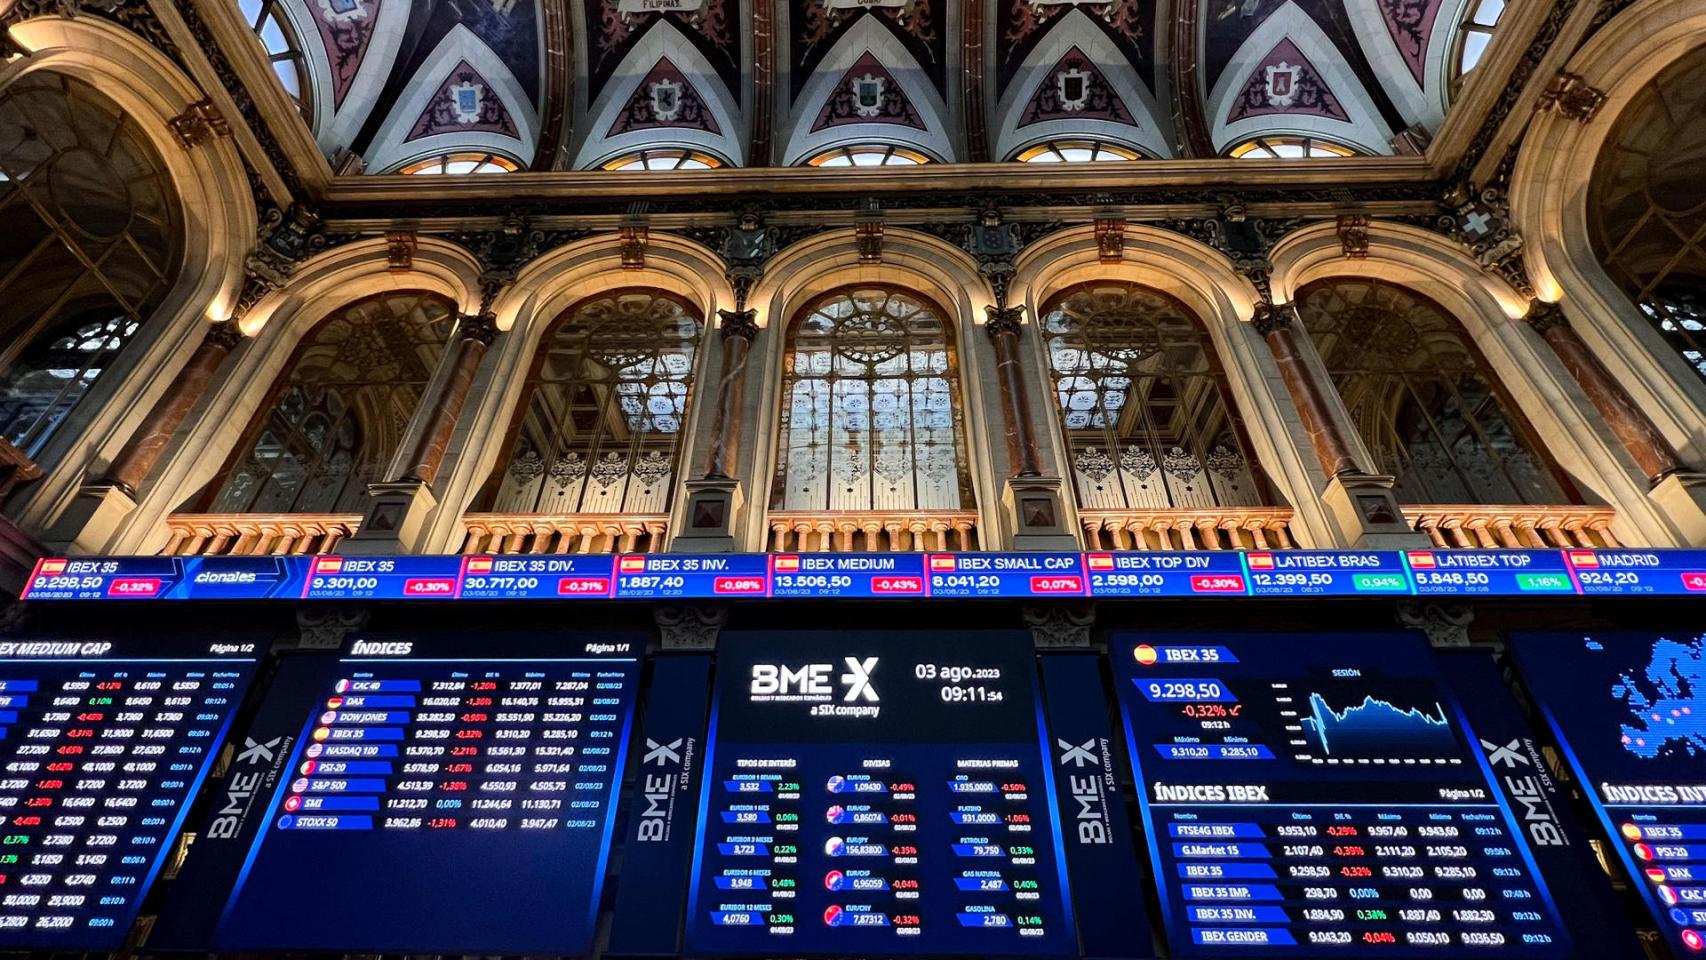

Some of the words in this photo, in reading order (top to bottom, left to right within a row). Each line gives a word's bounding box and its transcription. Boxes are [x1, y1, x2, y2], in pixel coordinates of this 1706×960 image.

[648, 560, 680, 570] IBEX
[682, 560, 699, 570] 35
[702, 560, 729, 570] INV.
[802, 559, 835, 570] IBEX
[838, 559, 895, 570] MEDIUM
[958, 558, 992, 569] IBEX
[995, 558, 1042, 569] SMALL
[1044, 558, 1074, 569] CAP
[1116, 557, 1150, 568] IBEX
[1151, 557, 1182, 568] TOP
[1186, 557, 1210, 568] DIV
[1275, 556, 1337, 568] LATIBEX
[1339, 556, 1380, 567] BRAS
[1436, 555, 1499, 567] LATIBEX
[1500, 555, 1531, 566] TOP
[1599, 554, 1660, 566] MADRID
[67, 562, 100, 573] IBEX
[101, 562, 119, 573] 35
[343, 561, 376, 572] IBEX
[378, 561, 395, 572] 35
[494, 560, 527, 572] IBEX
[529, 561, 546, 572] 35
[548, 560, 575, 572] DIV.
[34, 576, 102, 589] 9.298,50
[194, 571, 257, 583] cionales
[1092, 574, 1164, 587] 2.598,00
[1197, 579, 1238, 588] -0,30%
[1252, 574, 1333, 587] 12.399,50
[1362, 578, 1399, 587] 0,94%
[1415, 573, 1489, 585] 5.848,50
[1528, 577, 1562, 587] 1,16%
[1580, 572, 1639, 585] 924,20
[313, 578, 377, 589] 9.301,00
[410, 582, 450, 592] -0,30%
[465, 578, 538, 589] 30.717,00
[565, 582, 603, 592] -0,31%
[620, 577, 684, 589] 1.887,40
[775, 576, 851, 588] 13.506,50
[876, 581, 918, 590] -0,43%
[932, 576, 1000, 588] 8.041,20
[1036, 580, 1077, 590] -0,07%
[17, 642, 81, 655] MEDIUM
[81, 642, 111, 655] CAP
[210, 644, 239, 653] Página
[240, 644, 254, 652] 1/2
[351, 640, 413, 654] ÍNDICES
[586, 644, 615, 653] Página
[616, 644, 630, 652] 1/1
[1165, 649, 1200, 660] IBEX
[1201, 649, 1219, 660] 35
[915, 664, 936, 678] 03
[751, 664, 833, 694] BME
[353, 682, 368, 690] CAC
[370, 682, 380, 690] 40
[942, 686, 1002, 701] 09:11:54
[1149, 684, 1220, 700] 9.298,50
[346, 698, 364, 706] DAX
[810, 706, 818, 715] a
[818, 704, 835, 715] SIX
[836, 706, 880, 718] company
[1182, 705, 1226, 718] -0,32%
[358, 713, 388, 722] JONES
[333, 730, 352, 738] IBEX
[353, 730, 364, 738] 35
[274, 736, 294, 769] company
[326, 747, 361, 755] NASDAQ
[684, 738, 696, 770] company
[1100, 738, 1112, 772] company
[1171, 748, 1208, 757] 9.310,20
[1221, 748, 1258, 757] 9.285,10
[319, 764, 346, 772] PSI-20
[486, 764, 521, 772] 6.054,16
[534, 764, 570, 772] 5.971,64
[863, 760, 890, 768] DIVISAS
[958, 760, 991, 768] MATERIAS
[681, 772, 690, 784] SIX
[1105, 773, 1114, 785] SIX
[312, 782, 330, 790] S&P
[480, 782, 516, 790] 4.550,93
[530, 782, 566, 790] 4.505,75
[954, 784, 992, 792] 1.935,0000
[1154, 782, 1224, 800] ÍNDICES
[1227, 786, 1269, 800] IBEX
[1440, 789, 1469, 800] Página
[1470, 789, 1485, 798] 1/2
[1602, 782, 1678, 802] ÍNDICES
[207, 772, 259, 838] BME
[304, 800, 322, 808] SMI
[638, 774, 671, 841] BME
[1070, 775, 1106, 844] BME
[1504, 776, 1563, 846] BME
[296, 818, 326, 826] STOXX
[326, 818, 338, 826] 50
[470, 819, 507, 828] 4.010,40
[521, 819, 558, 828] 3.947,47
[1212, 826, 1235, 836] IBEX
[1644, 828, 1668, 837] IBEX
[1670, 828, 1682, 837] 35
[974, 846, 1000, 855] 79,750
[1182, 846, 1225, 855] G.Market
[1227, 846, 1239, 855] 15
[1284, 846, 1323, 856] 2.107,40
[1375, 846, 1416, 856] 2.111,20
[1427, 846, 1467, 856] 2.105,20
[1186, 866, 1210, 876] IBEX
[1211, 866, 1222, 876] 35
[1290, 866, 1330, 876] 9.298,50
[1382, 867, 1424, 877] 9.310,20
[1435, 867, 1476, 877] 9.285,10
[1668, 868, 1692, 878] DAX
[731, 879, 752, 888] 3,948
[854, 879, 882, 888] 0,96059
[981, 880, 1002, 889] 2,487
[1192, 888, 1216, 897] IBEX
[1216, 888, 1228, 897] 35
[1229, 888, 1250, 897] IMP.
[1304, 888, 1337, 898] 298,70
[1350, 888, 1379, 898] 0,00%
[1410, 888, 1432, 898] 0,00
[1463, 889, 1486, 899] 0,00
[1681, 890, 1703, 899] CAC
[770, 914, 793, 923] 0,30%
[1018, 916, 1042, 925] 0,14%
[1196, 909, 1220, 918] IBEX
[1222, 909, 1232, 918] 35
[1234, 909, 1256, 918] INV.
[1399, 910, 1440, 921] 1.887,40
[1202, 932, 1226, 941] IBEX
[1226, 932, 1268, 942] GENDER
[1309, 932, 1352, 942] 9.043,20
[1406, 932, 1449, 943] 9.050,10
[1462, 932, 1504, 943] 9.036,50
